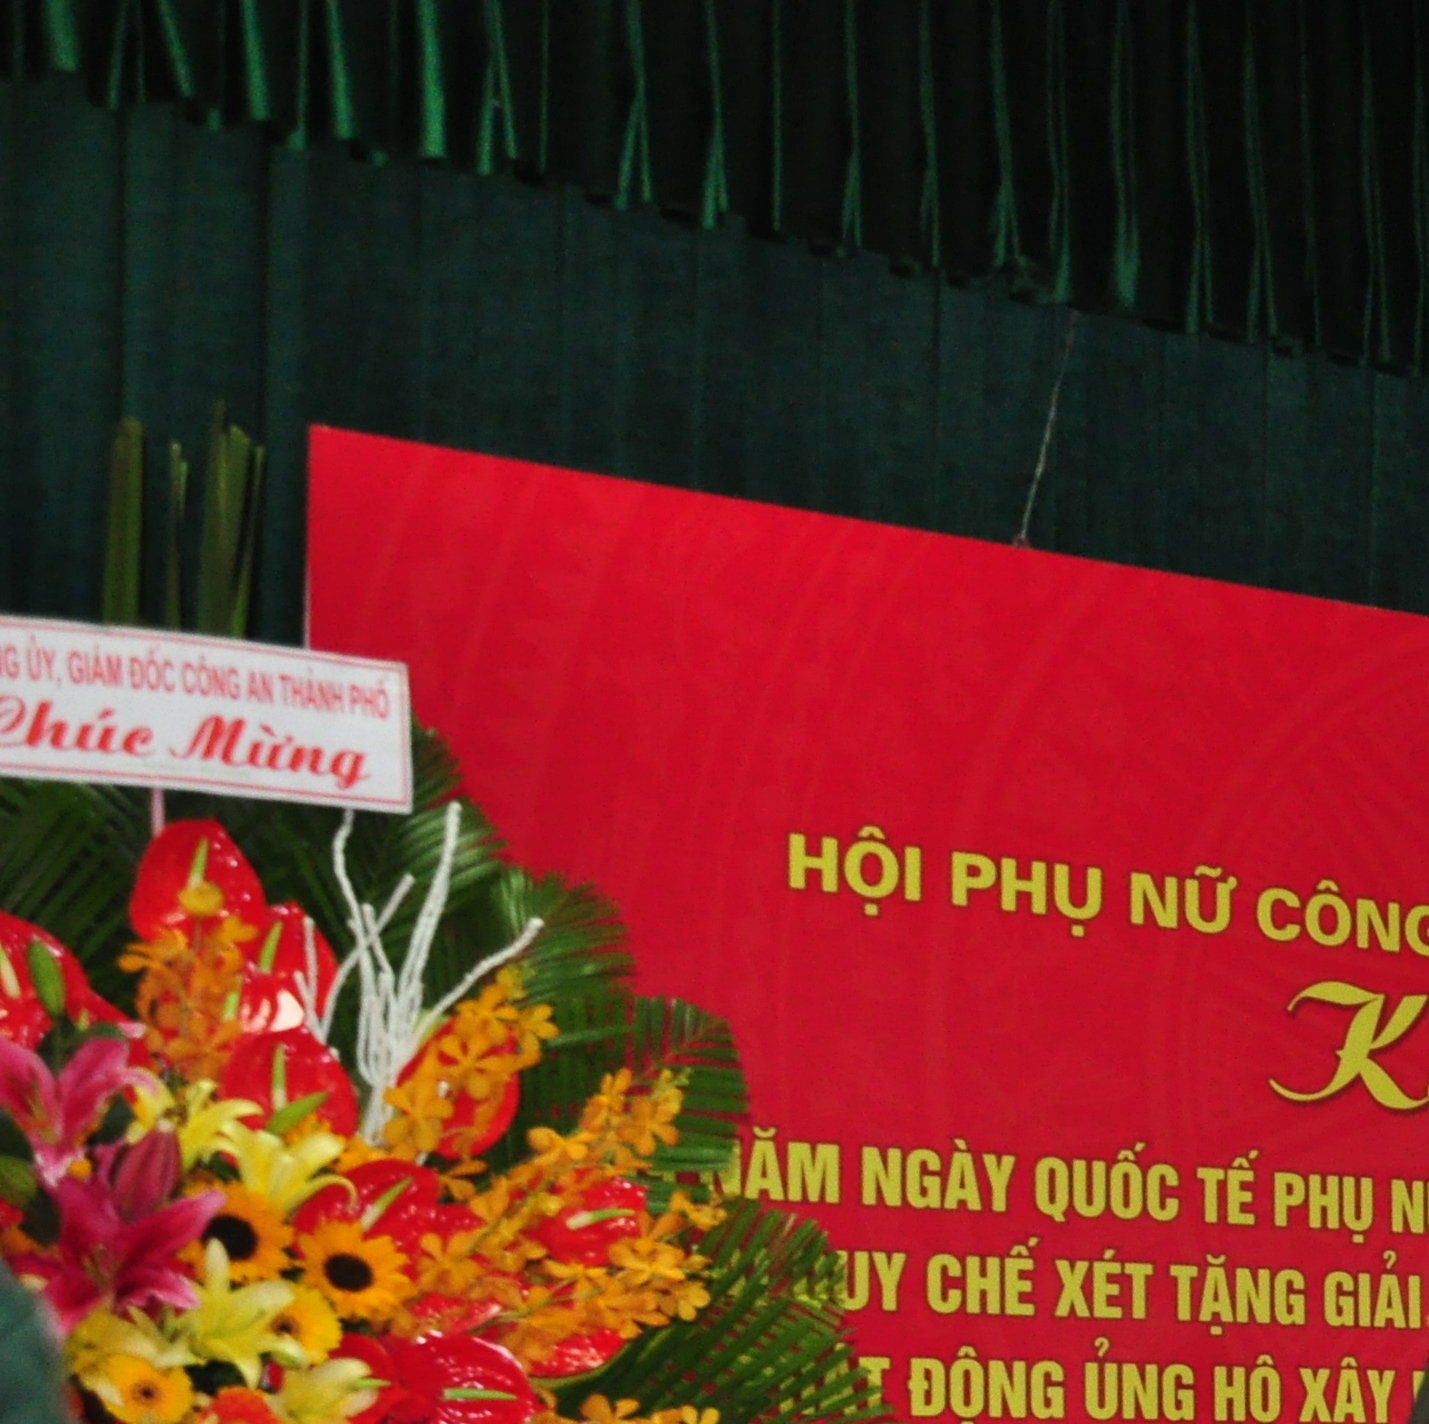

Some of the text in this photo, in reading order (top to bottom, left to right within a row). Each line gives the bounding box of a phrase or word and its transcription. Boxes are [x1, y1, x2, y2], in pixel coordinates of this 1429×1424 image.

[68, 644, 123, 686] GIÁM
[129, 646, 174, 691] ĐỐC
[182, 656, 241, 700] CÔNG
[248, 671, 274, 703] AN
[279, 667, 344, 713] THÀNH
[349, 675, 390, 720] PHỐ
[169, 714, 371, 789] Mừng
[788, 826, 921, 916] HỘI
[951, 852, 1102, 936] PHỤ
[1129, 866, 1237, 934] NỮ
[862, 1138, 1016, 1212] NGÀY
[1035, 1142, 1180, 1222] QUỐC
[1197, 1150, 1260, 1225] TẾ
[1274, 1171, 1374, 1243] PHỤ
[927, 1238, 1040, 1315] CHẾ
[1055, 1249, 1153, 1320] XÉT
[1170, 1254, 1305, 1335] TẶNG
[1324, 1250, 1421, 1329] GIẢI
[1085, 1337, 1195, 1421] ỦNG
[1299, 1357, 1396, 1424] XÂY
